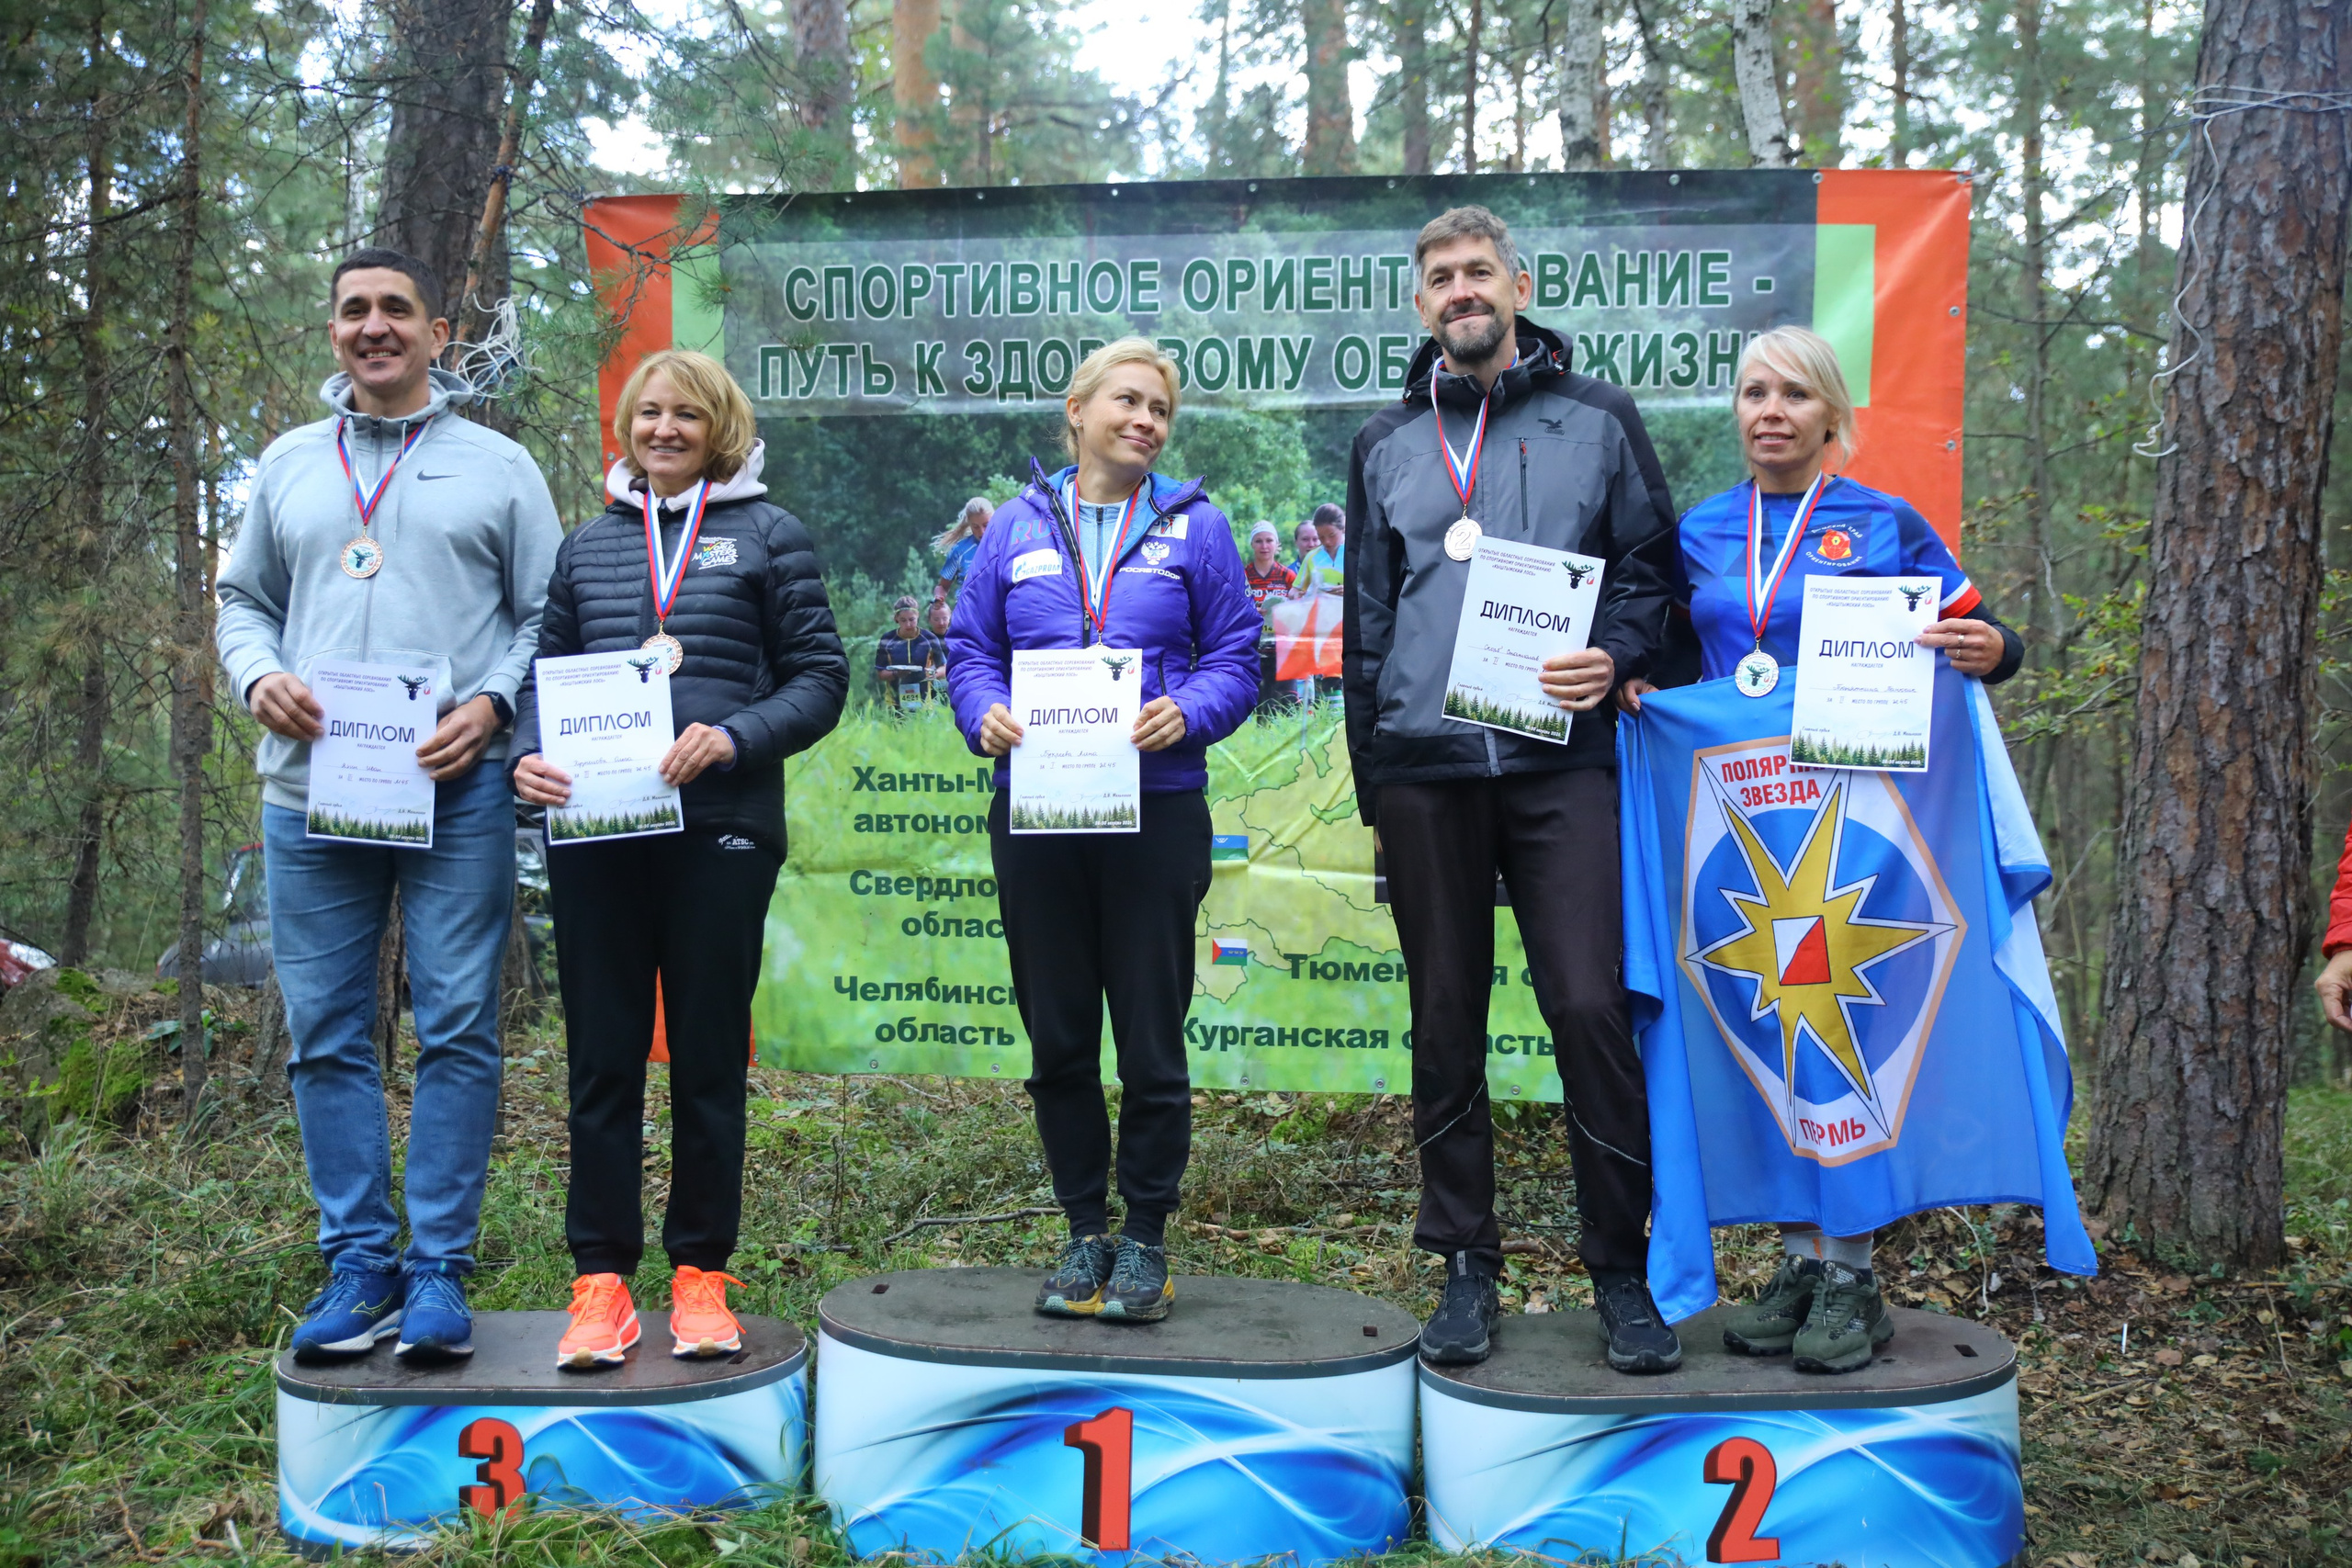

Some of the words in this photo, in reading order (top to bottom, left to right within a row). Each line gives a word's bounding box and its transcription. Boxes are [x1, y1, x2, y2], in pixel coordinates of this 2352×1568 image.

[784, 258, 1161, 321] СПОРТИВНОЕ
[1182, 249, 1732, 312] ОРИЕНТВАНИЕ
[759, 343, 895, 399] ПУТЬ
[916, 341, 946, 396] К
[963, 334, 1311, 404] ЗДОВОМУ
[1577, 330, 1761, 389] ЖИЗН
[1119, 567, 1181, 581] РОСАВТОДОР
[1480, 600, 1570, 633] ДИПЛОМ
[1819, 639, 1914, 658] ДИПЛОМ
[330, 719, 414, 743] ДИПЛОМ
[560, 711, 651, 736] ДИПЛОМ
[1029, 707, 1118, 726] ДИПЛОМ
[1721, 755, 1825, 783] ПОЛЯР
[1740, 779, 1821, 807] ЗВЕЗДА
[876, 1016, 1015, 1045] область
[1182, 1017, 1389, 1053] Курганская
[1798, 1117, 1866, 1147] ПЕРМЬ
[458, 1417, 527, 1527] 3
[1064, 1406, 1135, 1551] 1
[1703, 1436, 1781, 1564] 2
